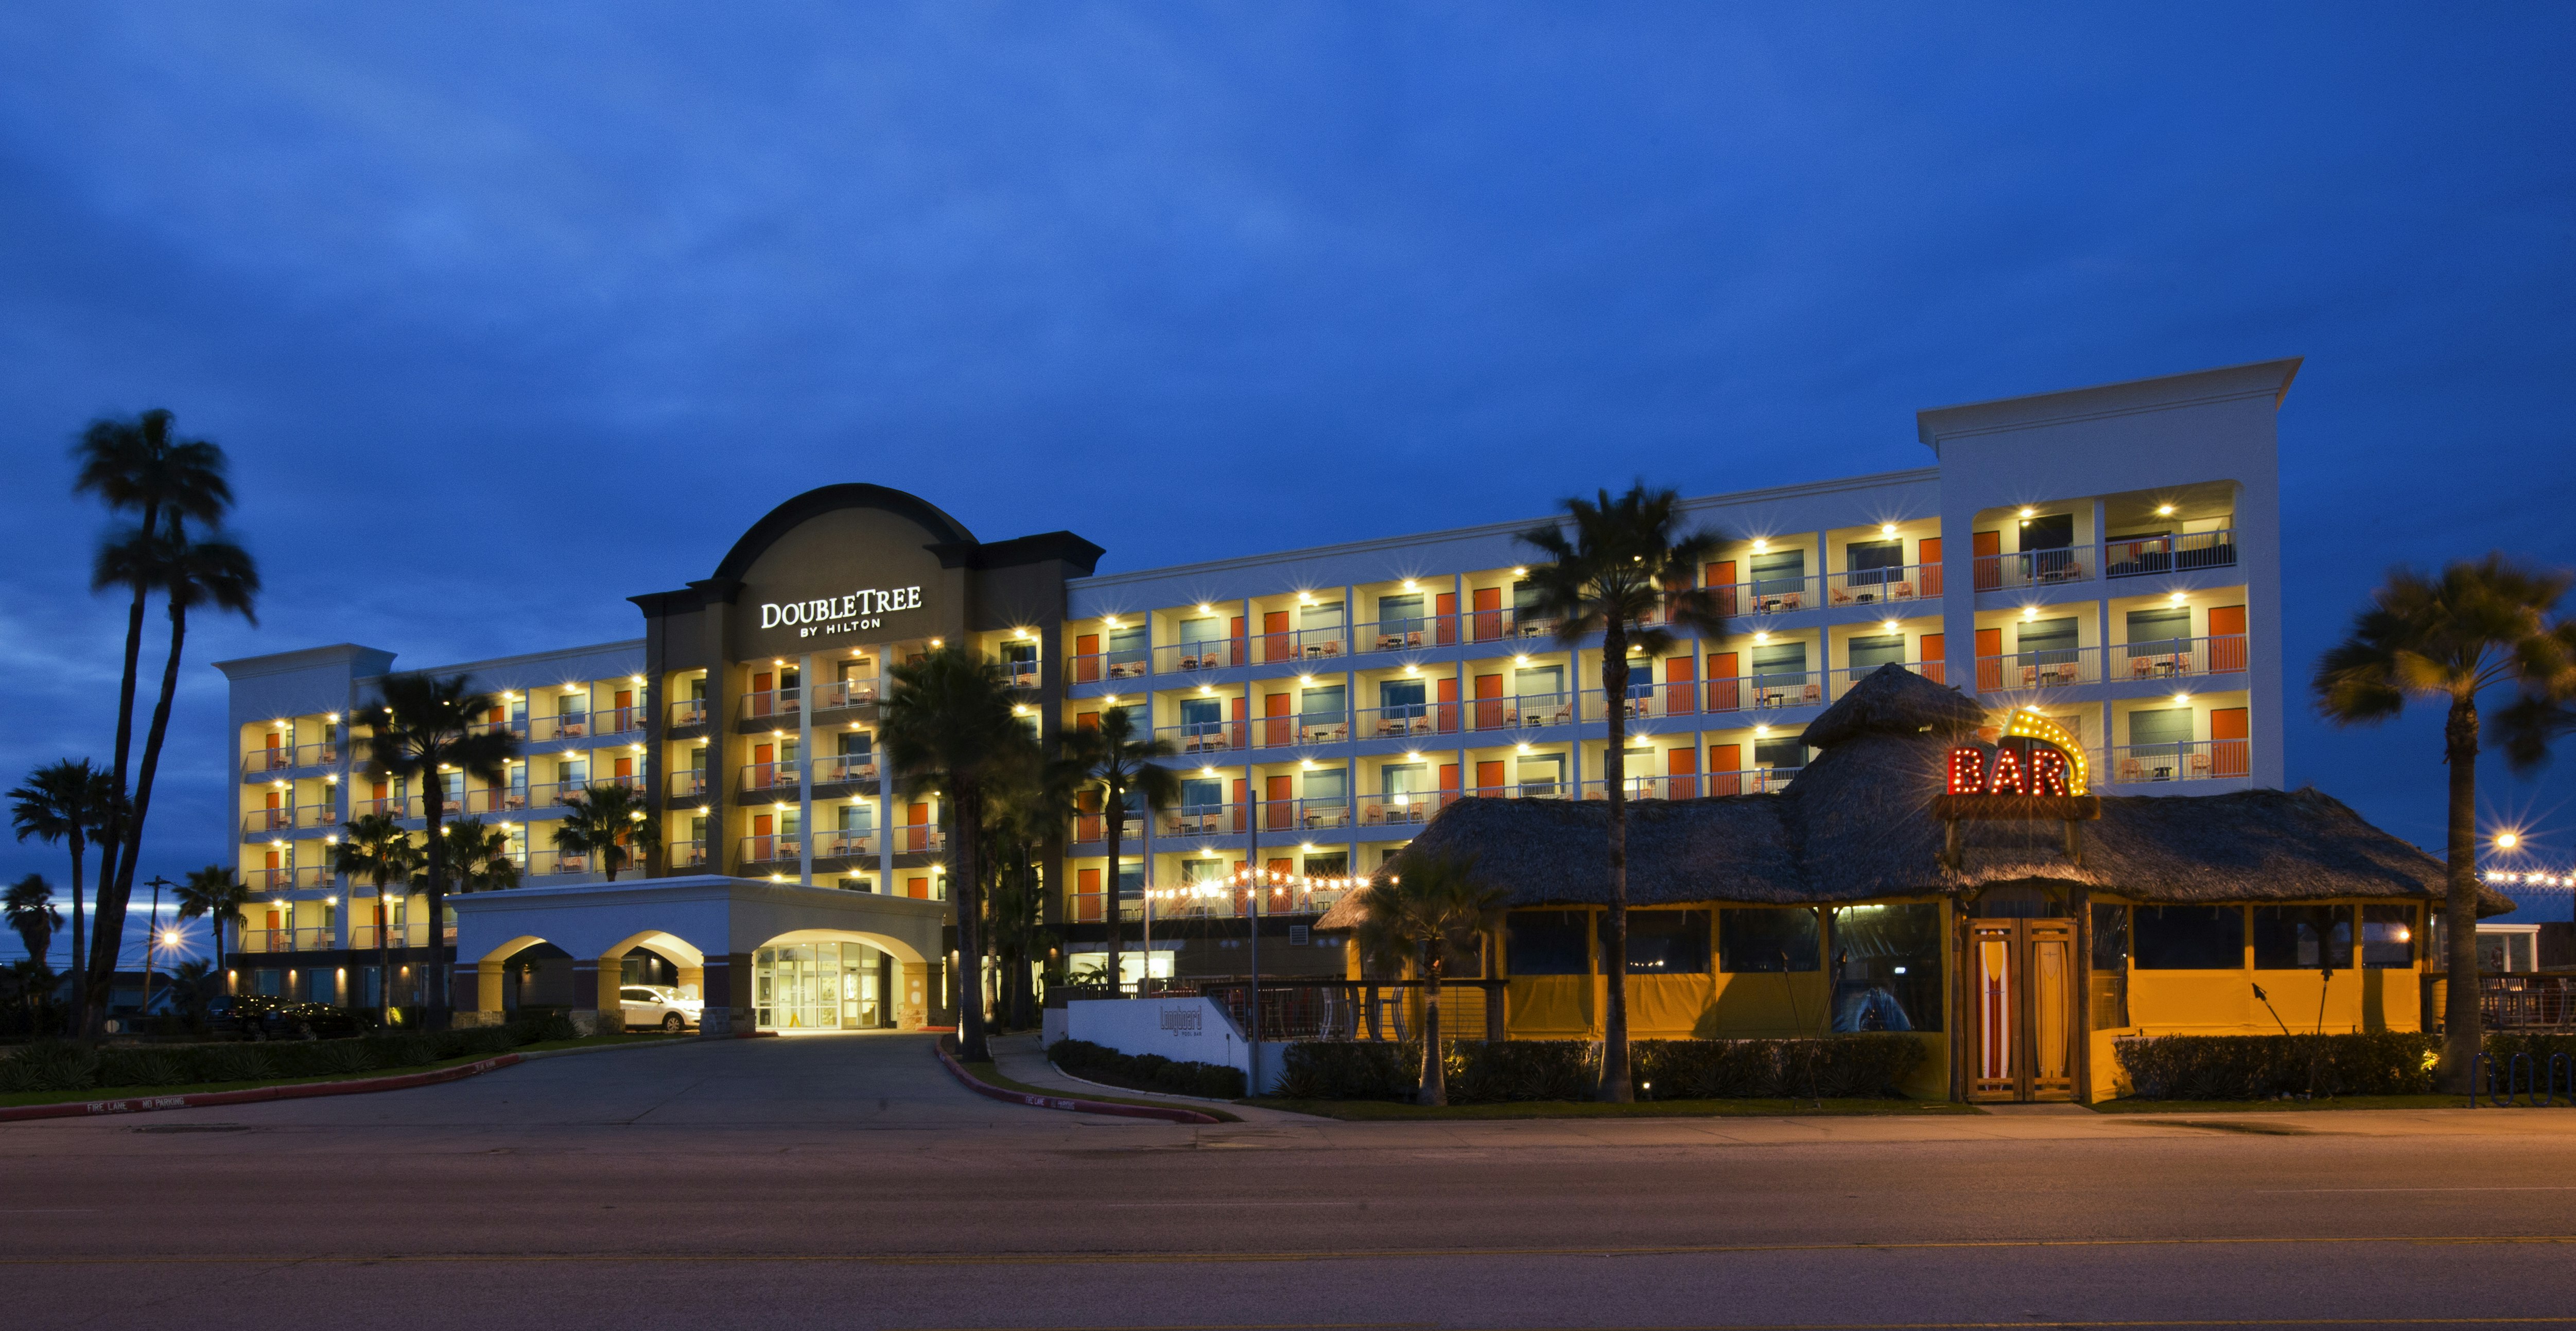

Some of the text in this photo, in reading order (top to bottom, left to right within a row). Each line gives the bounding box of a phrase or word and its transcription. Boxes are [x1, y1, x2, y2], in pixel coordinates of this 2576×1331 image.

[761, 586, 922, 628] DOUBLETREE
[800, 619, 880, 638] BY HILTON
[1947, 747, 2066, 796] BAR
[87, 1103, 104, 1112] FIRE
[108, 1101, 127, 1111] LANE
[142, 1100, 152, 1108] NO
[155, 1097, 184, 1107] PARKING
